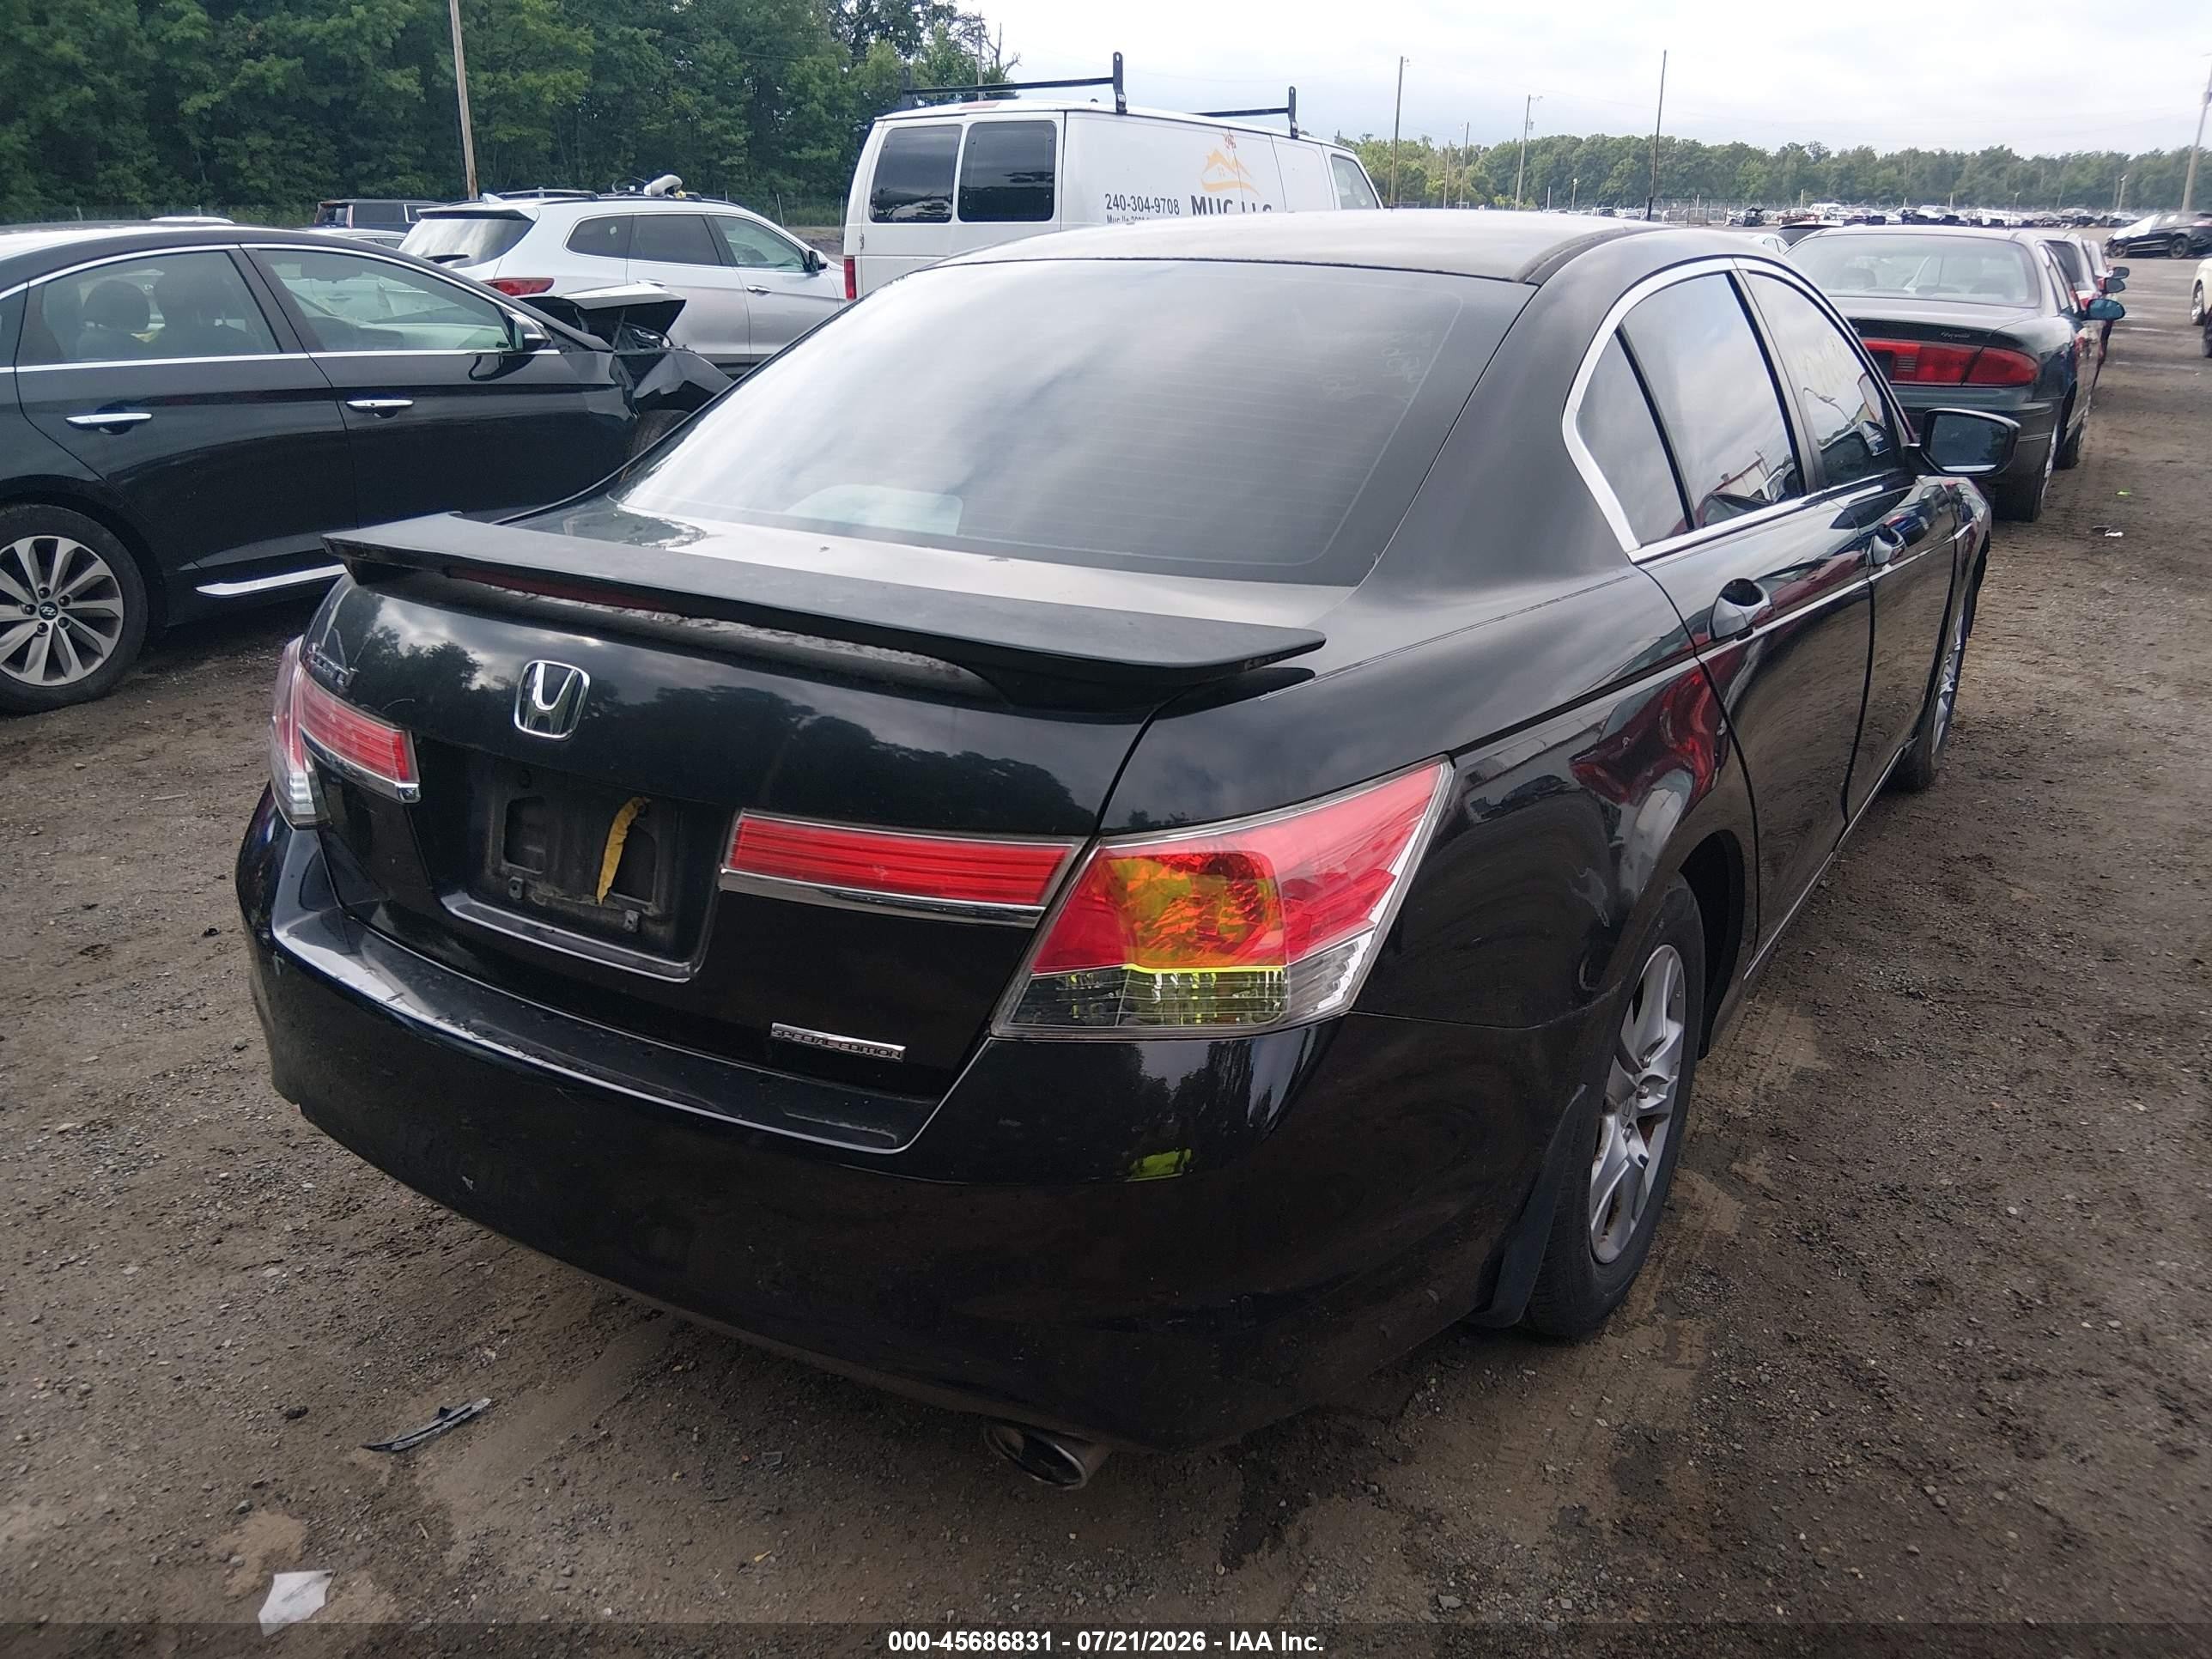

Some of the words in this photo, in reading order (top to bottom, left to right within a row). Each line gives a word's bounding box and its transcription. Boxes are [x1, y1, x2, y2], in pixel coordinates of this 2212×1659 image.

[1104, 193, 1180, 216] 240-304-9708
[773, 1030, 835, 1048] SPECIAL
[838, 1042, 902, 1059] EDITION
